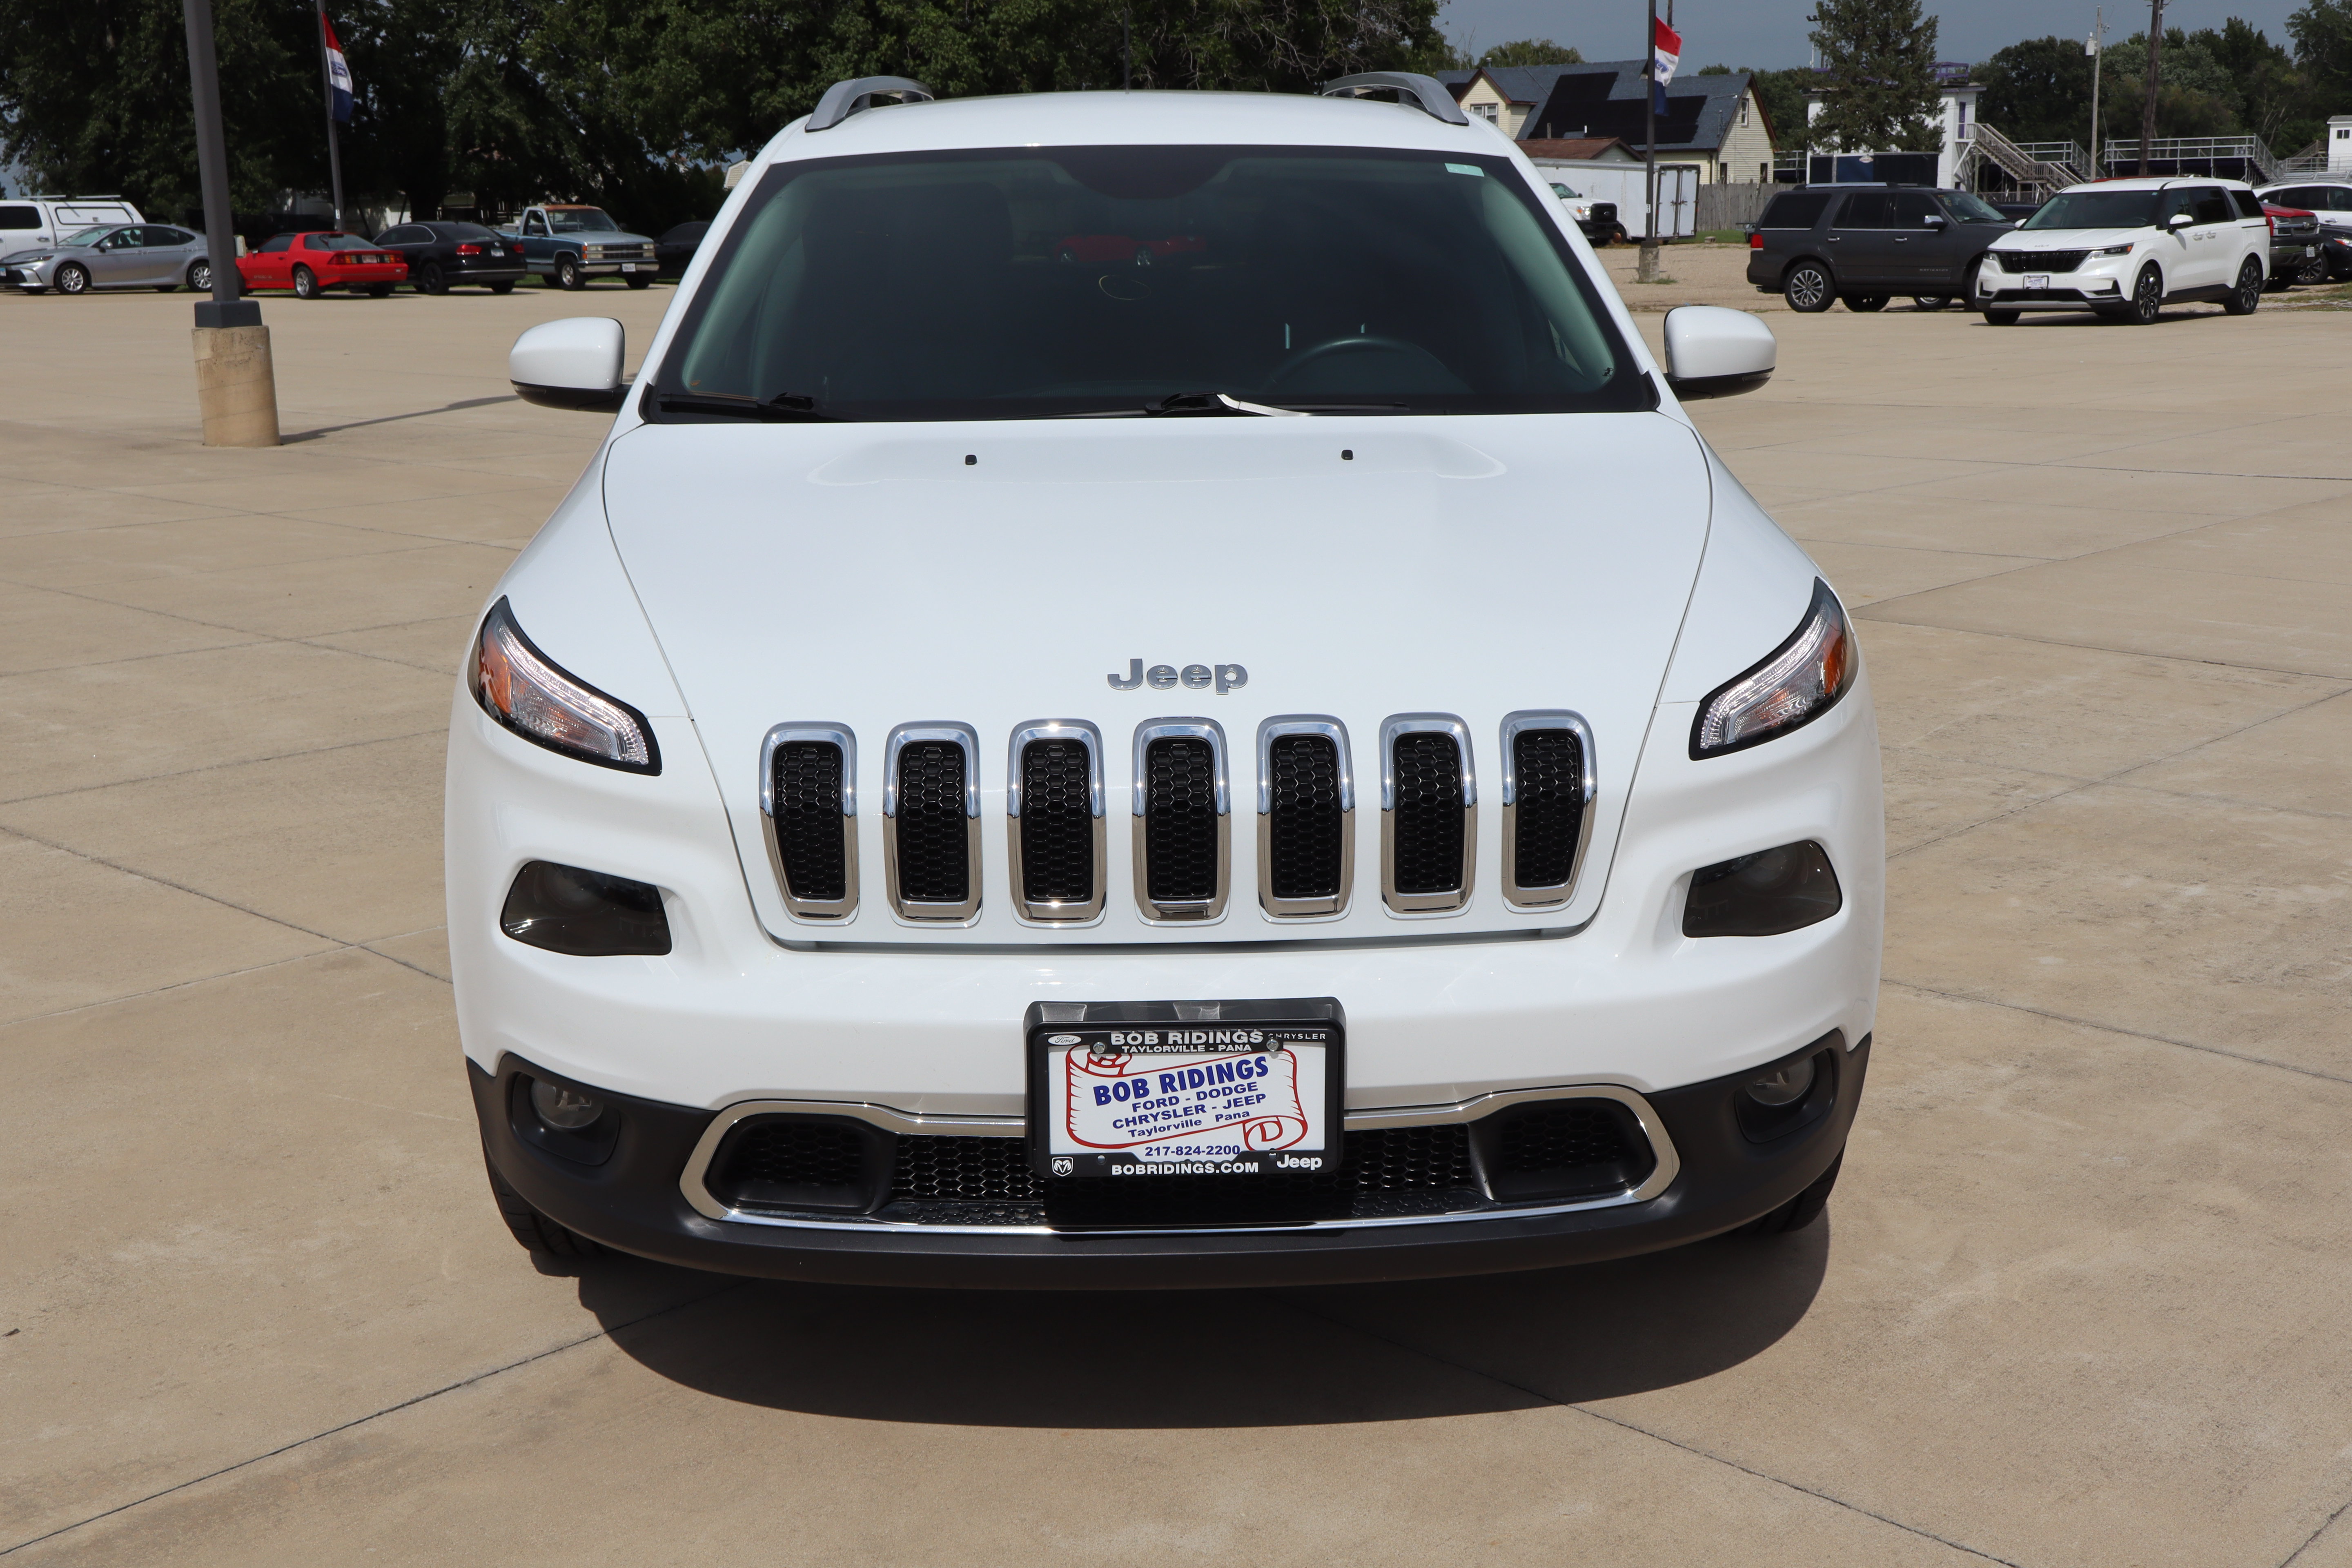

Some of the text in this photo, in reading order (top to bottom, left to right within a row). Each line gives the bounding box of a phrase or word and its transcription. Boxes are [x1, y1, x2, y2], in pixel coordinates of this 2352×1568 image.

[1107, 658, 1248, 695] Jeep
[1111, 1031, 1264, 1045] BOB RIDINGS
[1093, 1056, 1268, 1106] BOB RIDINGS
[1132, 1096, 1180, 1113] FORD
[1196, 1081, 1258, 1101] DODGE
[1113, 1104, 1207, 1129] CHRYSLER
[1222, 1093, 1266, 1109] JEEP
[1128, 1111, 1250, 1138] Taylorville Pana
[1145, 1145, 1240, 1156] 217-824-2200
[1276, 1154, 1322, 1171] Jeep
[1111, 1162, 1258, 1175] BOBRIDINGS.COM
